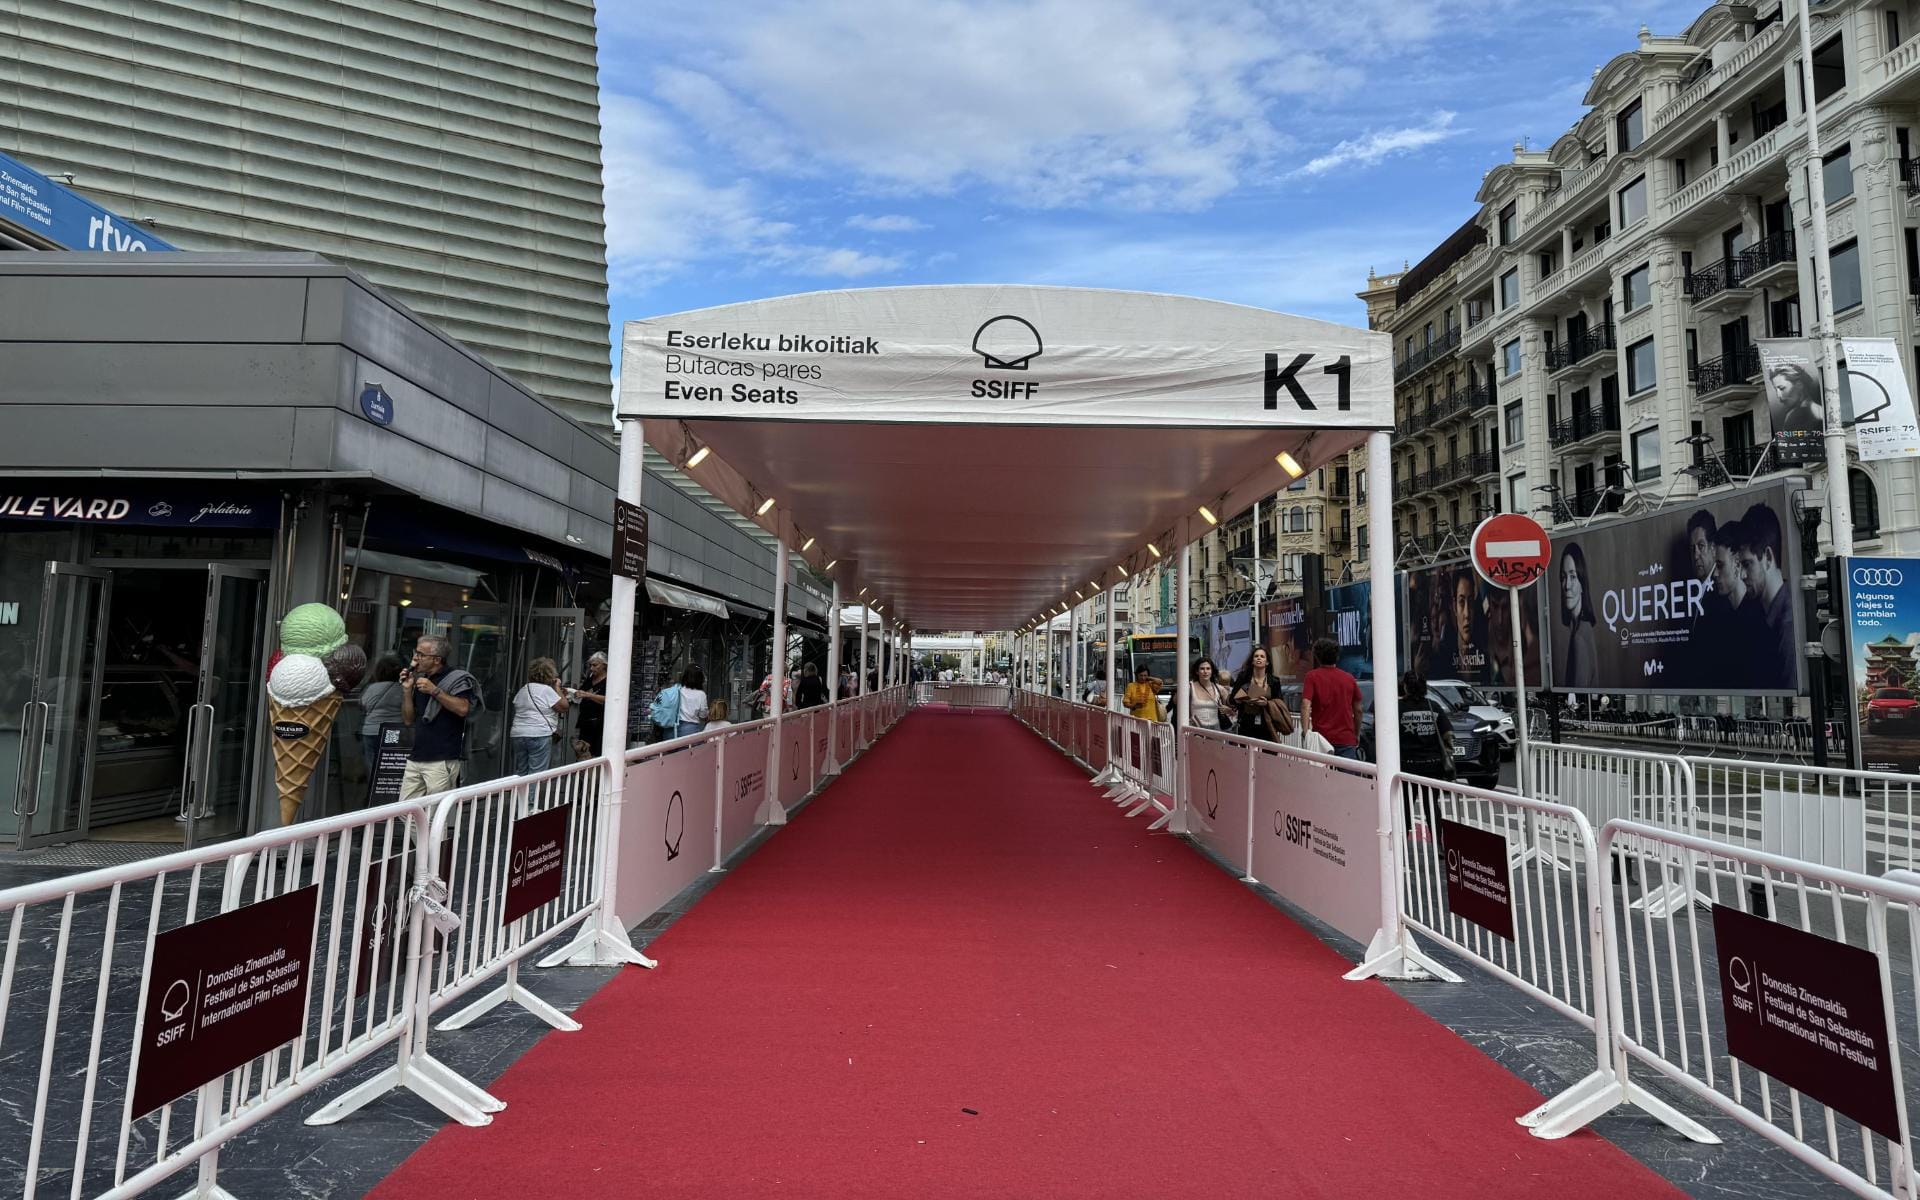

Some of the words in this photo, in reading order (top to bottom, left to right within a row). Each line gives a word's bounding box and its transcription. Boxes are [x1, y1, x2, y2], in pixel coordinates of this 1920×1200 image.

[1, 170, 38, 196] Zinemaldia
[6, 185, 19, 198] San
[20, 192, 52, 216] Sebastián
[11, 200, 25, 213] Film
[26, 208, 51, 226] Festival
[666, 330, 770, 351] Eserleku
[778, 334, 880, 354] bikoitiak
[666, 354, 755, 376] Butacas
[762, 362, 822, 381] pares
[664, 380, 723, 401] Even
[731, 384, 798, 404] Seats
[970, 380, 1040, 400] SSIFF
[1264, 352, 1352, 411] K1
[1856, 592, 1894, 601] Algunos
[1856, 602, 1882, 610] viajes
[1644, 659, 1664, 676] M+
[1286, 814, 1311, 849] SSIFF
[1450, 873, 1458, 883] SSIFF
[206, 964, 244, 988] Donostia
[245, 948, 286, 972] Zinemaldia
[204, 984, 236, 1008] Festival
[238, 980, 248, 993] de
[250, 974, 264, 989] San
[266, 960, 300, 981] Sebastián
[1762, 972, 1797, 998] Donostia
[1799, 987, 1848, 1018] Zinemaldia
[201, 997, 253, 1028] International
[254, 990, 270, 1006] Film
[272, 976, 299, 998] Festival
[1732, 994, 1753, 1013] SSIFF
[1764, 991, 1794, 1015] Festival
[1796, 1006, 1807, 1020] de
[1809, 1010, 1825, 1028] San
[1827, 1018, 1874, 1049] Sebastián
[157, 1023, 186, 1047] SSIFF
[1767, 1010, 1817, 1043] International
[1819, 1033, 1839, 1053] Film
[1840, 1042, 1877, 1071] Festival
